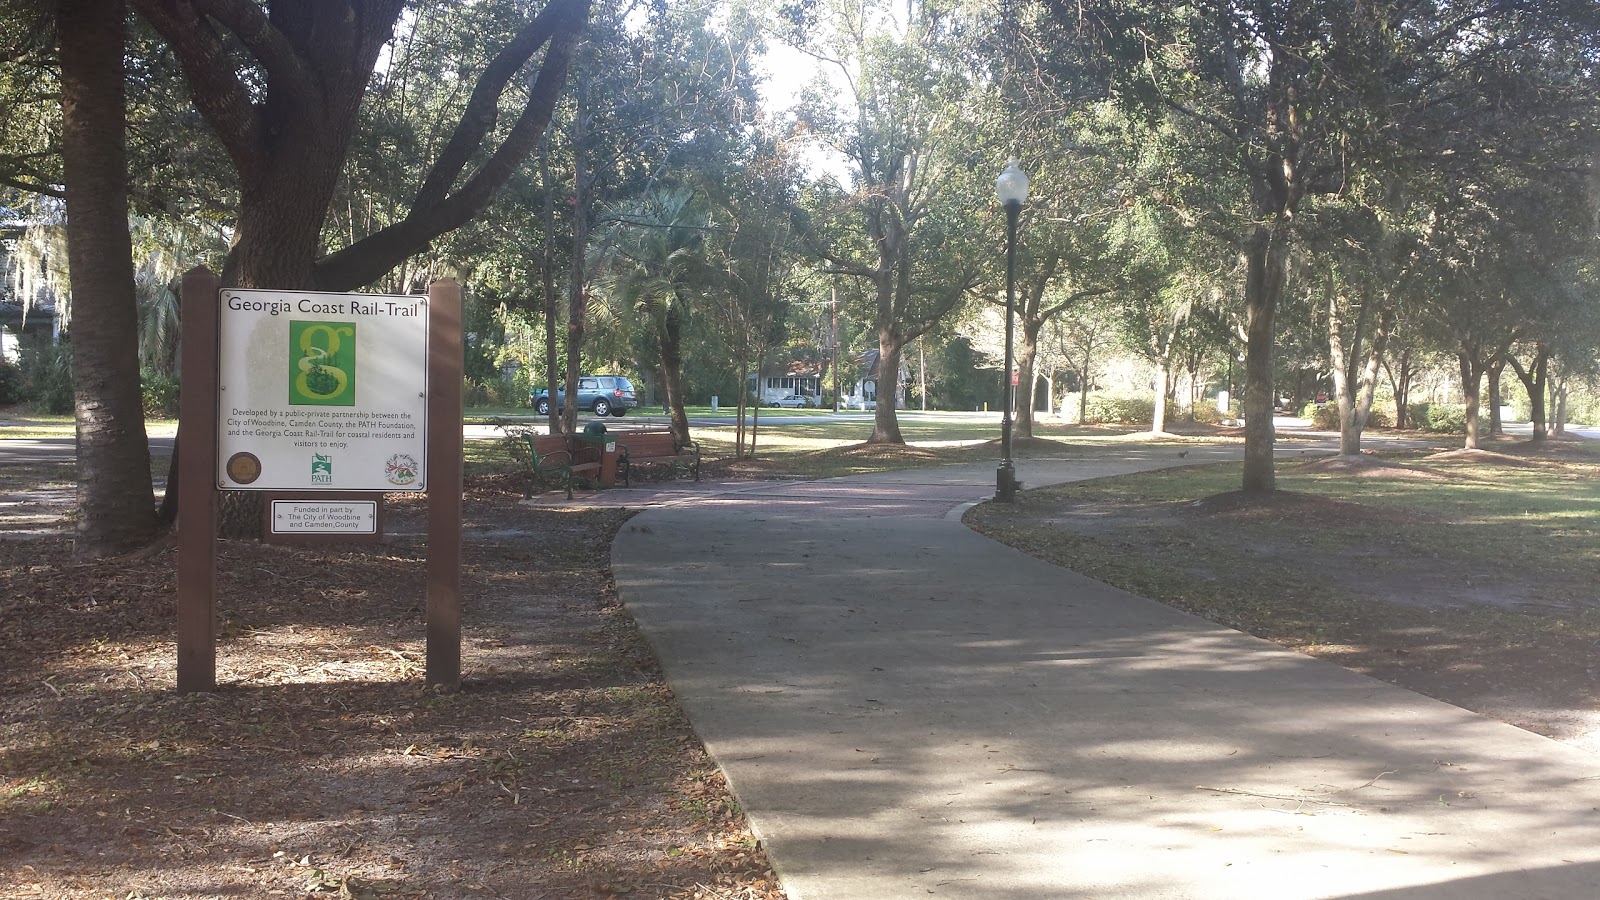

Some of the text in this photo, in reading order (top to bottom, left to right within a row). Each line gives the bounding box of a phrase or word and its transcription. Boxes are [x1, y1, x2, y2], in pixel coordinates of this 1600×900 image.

[228, 297, 418, 317] Georgia Coast Rail-Trail
[232, 408, 268, 418] Developed
[270, 410, 277, 418] by
[286, 410, 330, 418] public-private
[332, 411, 370, 419] partnership
[227, 418, 241, 427] City
[318, 420, 344, 429] County,
[256, 429, 281, 438] Georgia
